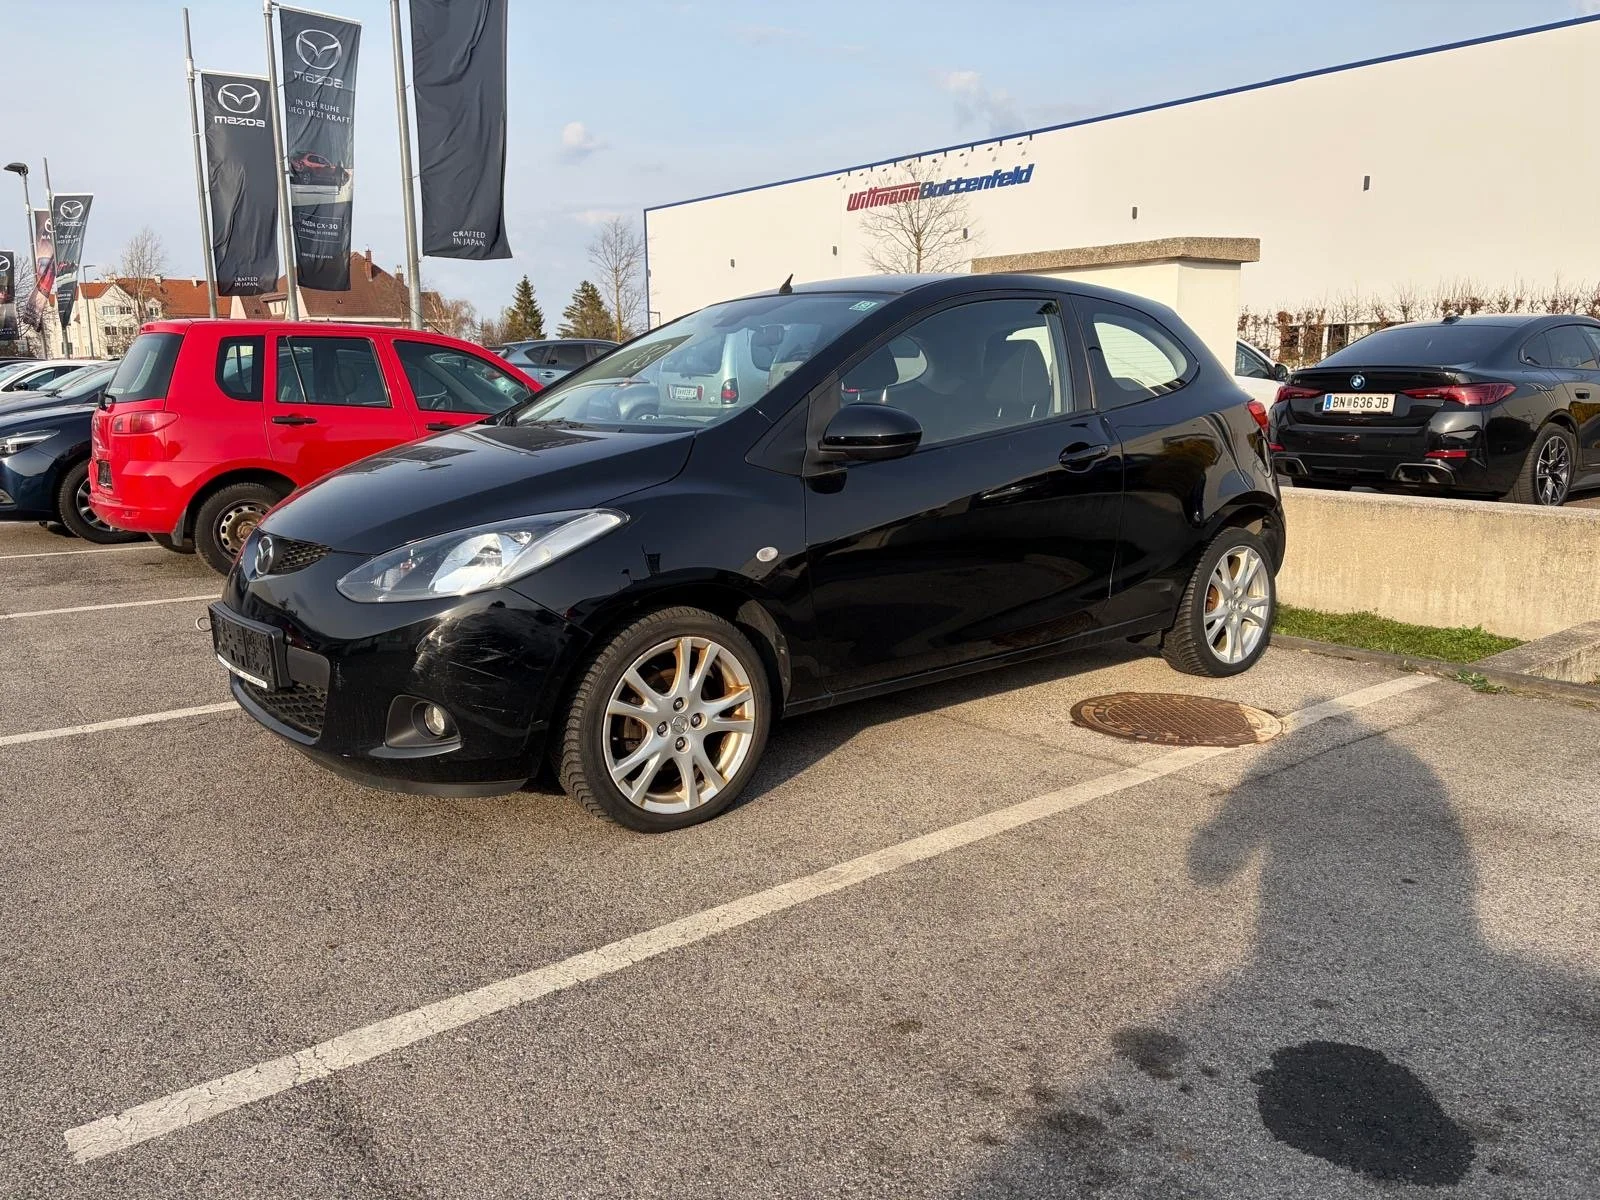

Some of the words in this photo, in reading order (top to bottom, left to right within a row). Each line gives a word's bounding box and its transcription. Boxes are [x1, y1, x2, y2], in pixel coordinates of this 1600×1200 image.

[293, 70, 343, 89] mazda
[295, 98, 303, 106] IN
[320, 103, 340, 113] RUHE
[214, 115, 266, 128] mazda
[326, 113, 351, 124] KRAFT
[452, 230, 486, 239] CRAFTED
[1333, 396, 1346, 408] BN
